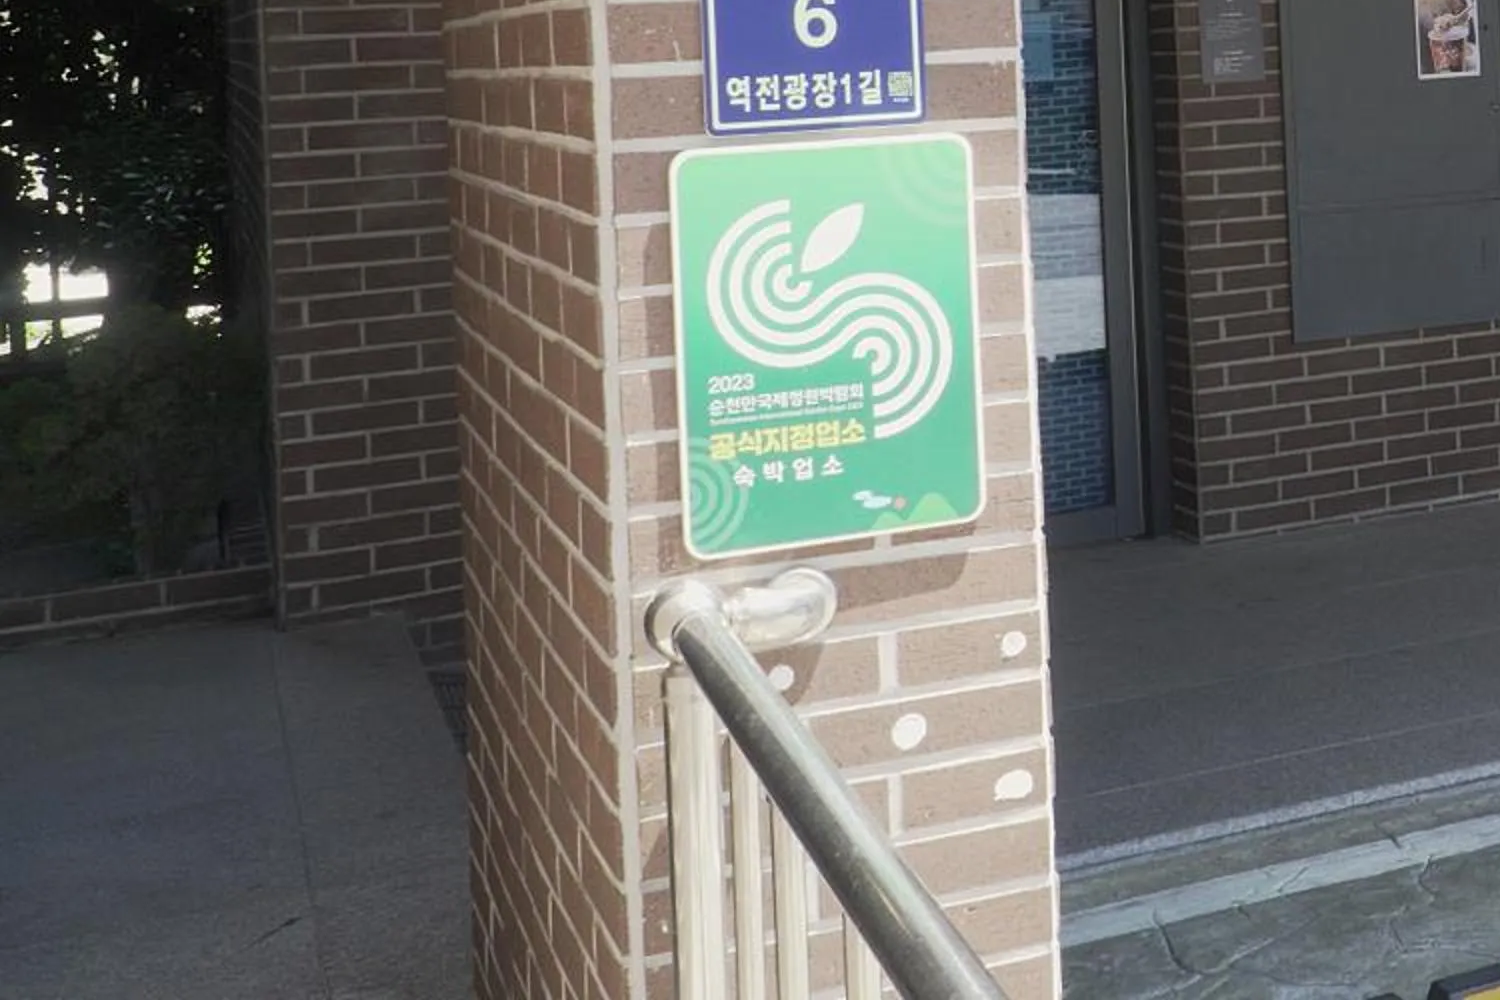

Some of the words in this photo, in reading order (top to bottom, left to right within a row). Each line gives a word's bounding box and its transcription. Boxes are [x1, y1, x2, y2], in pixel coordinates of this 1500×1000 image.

[725, 68, 883, 112] 역전광장1길
[706, 373, 756, 395] 2023
[708, 418, 867, 460] 공식지정업소
